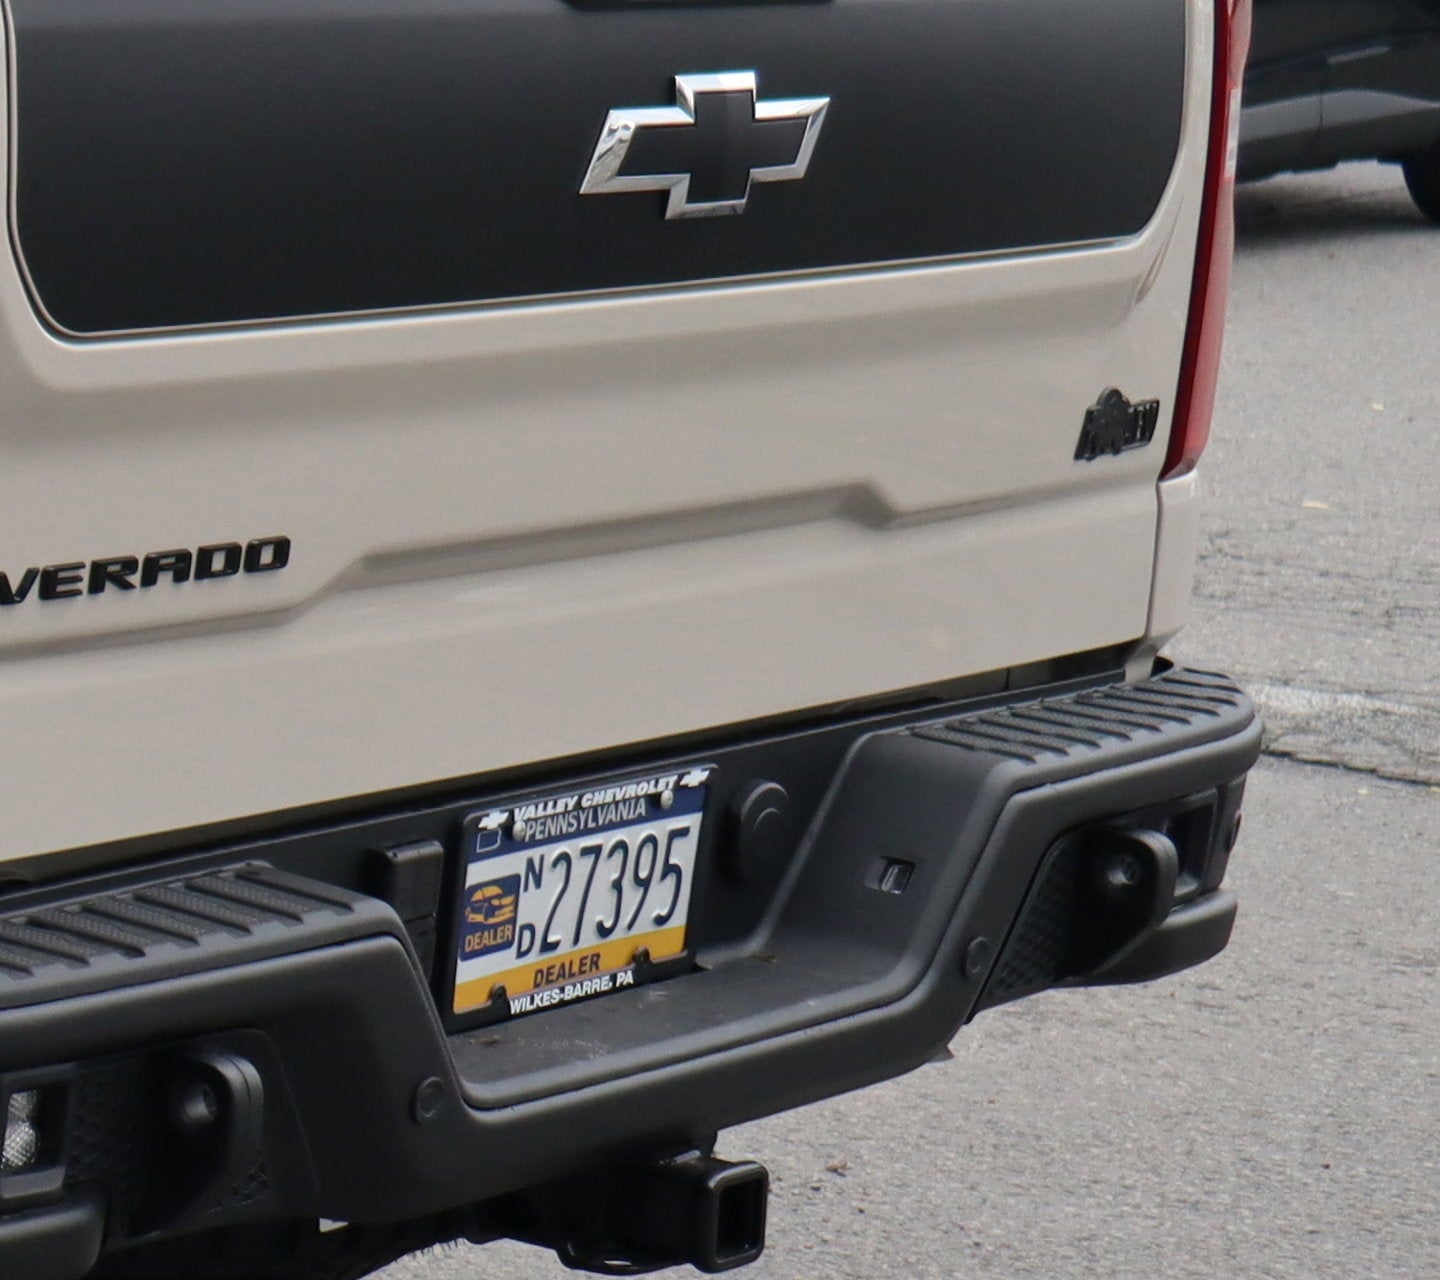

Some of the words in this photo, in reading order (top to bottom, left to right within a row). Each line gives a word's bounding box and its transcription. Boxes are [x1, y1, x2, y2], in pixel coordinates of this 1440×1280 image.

[512, 793, 580, 822] VALLEY
[580, 774, 679, 809] CHEVROLET
[523, 797, 647, 842] PENNSYLVANIA
[539, 823, 691, 955] 27395
[464, 923, 514, 953] DEALER
[509, 979, 615, 1016] WILKES-BARRE,
[615, 970, 635, 989] PA
[532, 952, 602, 989] DEALER
